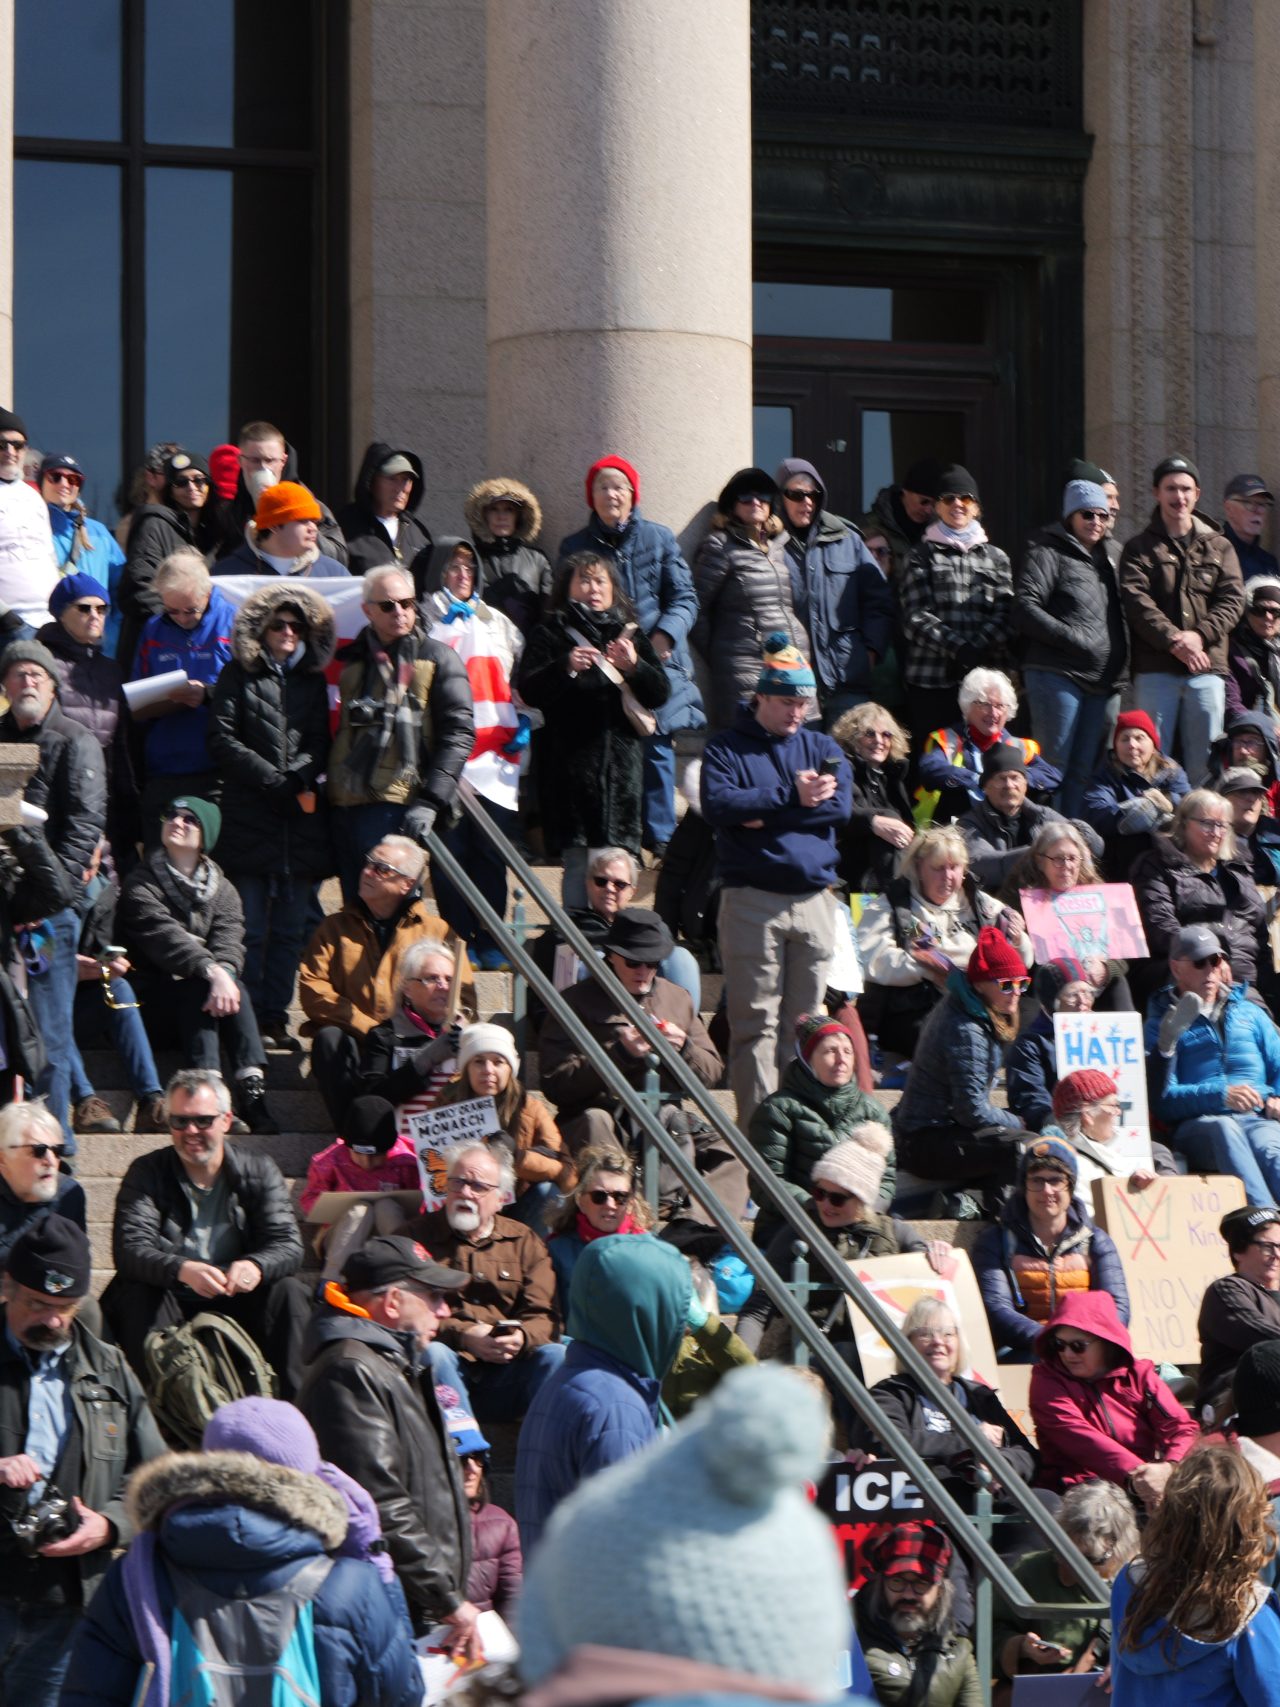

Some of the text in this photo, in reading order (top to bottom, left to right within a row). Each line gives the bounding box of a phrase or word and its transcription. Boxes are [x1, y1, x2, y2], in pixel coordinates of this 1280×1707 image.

[1064, 1031, 1138, 1066] HATE
[411, 1098, 495, 1127] THE ONLY ORANGE
[418, 1115, 486, 1139] MONARCH
[429, 1136, 448, 1148] WE
[1190, 1191, 1221, 1214] NO
[1138, 1278, 1178, 1311] NO
[1145, 1314, 1186, 1350] NO
[834, 1470, 925, 1512] ICE
